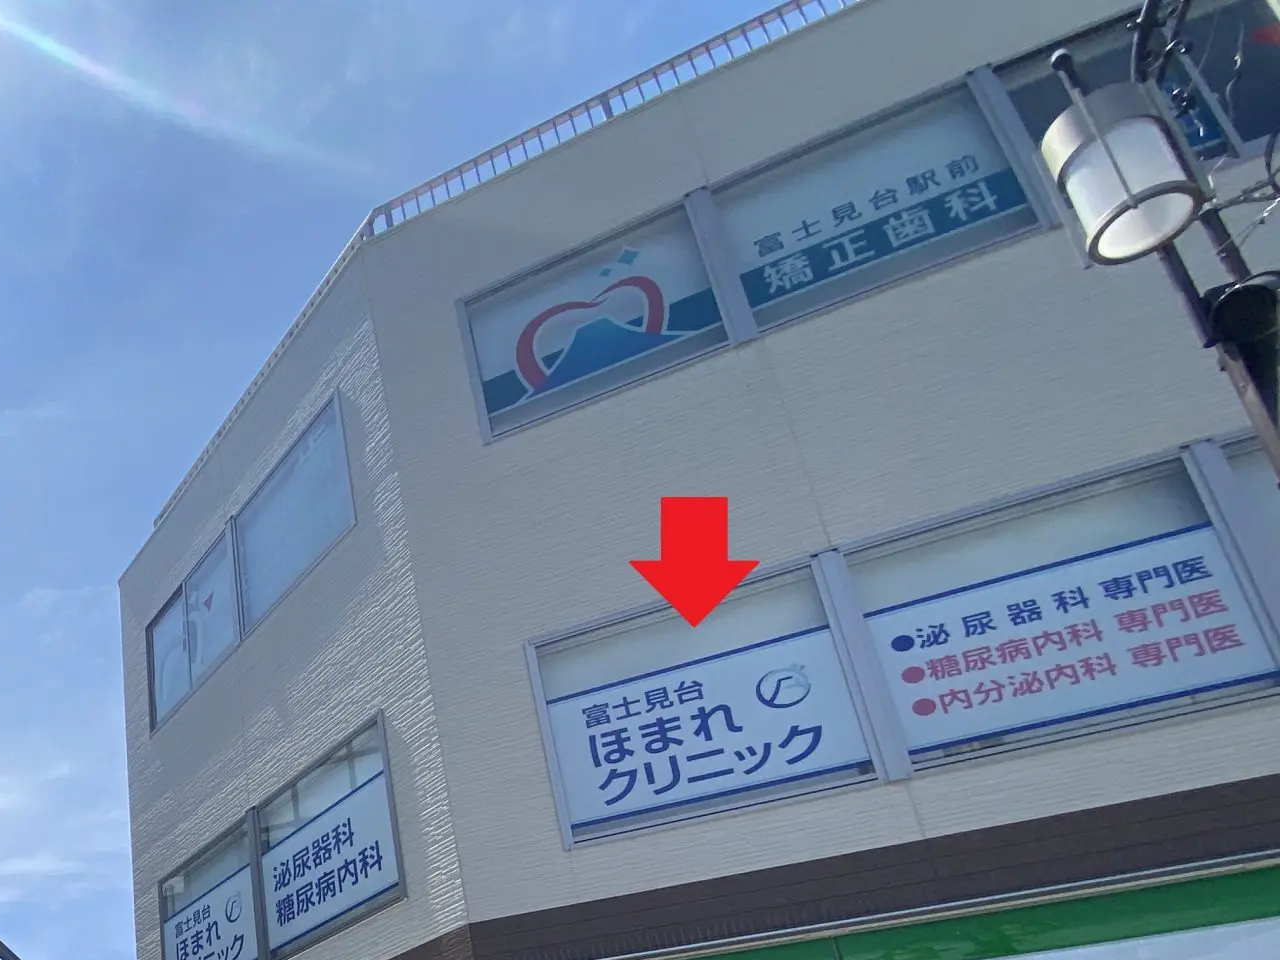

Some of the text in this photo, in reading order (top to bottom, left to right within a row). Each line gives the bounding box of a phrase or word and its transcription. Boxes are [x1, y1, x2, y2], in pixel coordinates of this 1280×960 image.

[753, 154, 980, 258] 富士見台駅前
[763, 181, 999, 294] 矯正歯科
[915, 555, 1214, 649] 泌尿器科 専門医
[924, 588, 1230, 681] 糖尿病内科 専門医
[581, 679, 705, 730] 富士見台
[937, 623, 1247, 714] 内分泌内科 専門医
[588, 703, 744, 768] ほまれ
[598, 724, 823, 806] クリニック
[272, 816, 355, 893] 泌尿器科
[274, 839, 384, 927] 糖尿病内科
[174, 903, 211, 940] 富士見台
